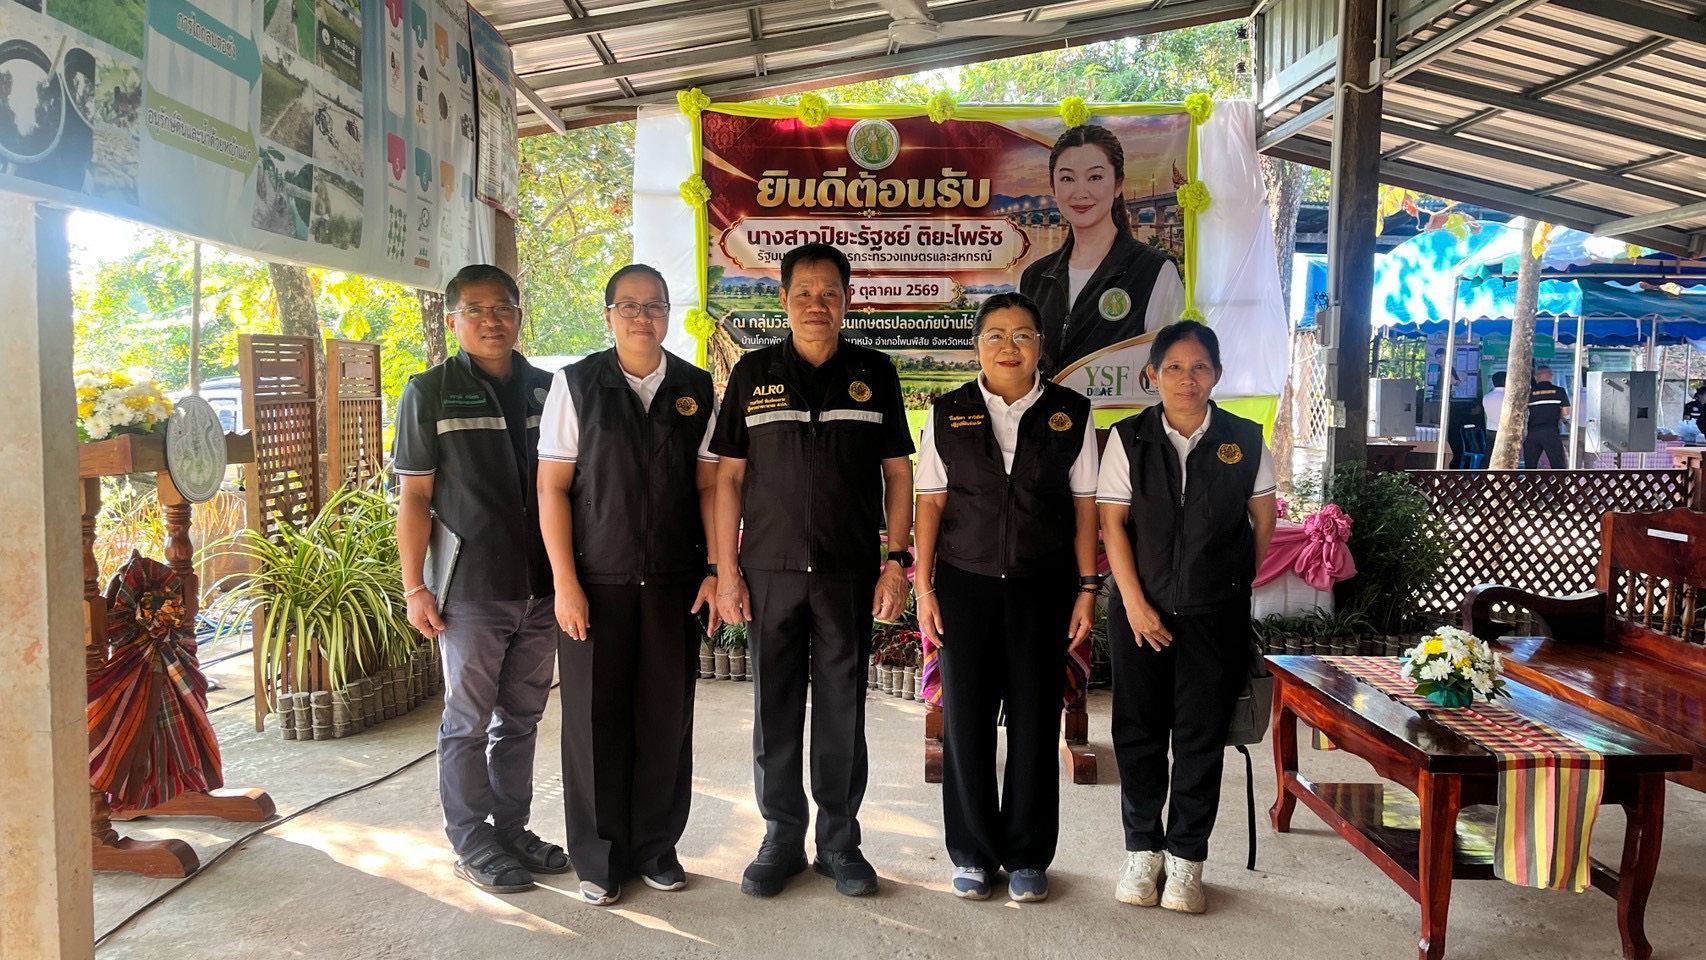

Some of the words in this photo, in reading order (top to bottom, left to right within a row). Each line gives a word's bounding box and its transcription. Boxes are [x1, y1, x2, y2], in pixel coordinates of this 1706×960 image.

[756, 167, 992, 208] ยินดีต้อนรับ
[747, 224, 910, 252] นางสาวปิยะรัฐชย์
[917, 223, 1003, 246] ติยะไพรัช
[860, 284, 902, 300] ตุลาคม
[906, 284, 939, 296] 2569
[732, 318, 746, 329] ณ
[875, 336, 930, 347] อำเภอโพนพิสัย
[932, 336, 974, 347] จังหวัดหนอ
[1084, 366, 1130, 396] YSF
[752, 384, 785, 397] ALRO
